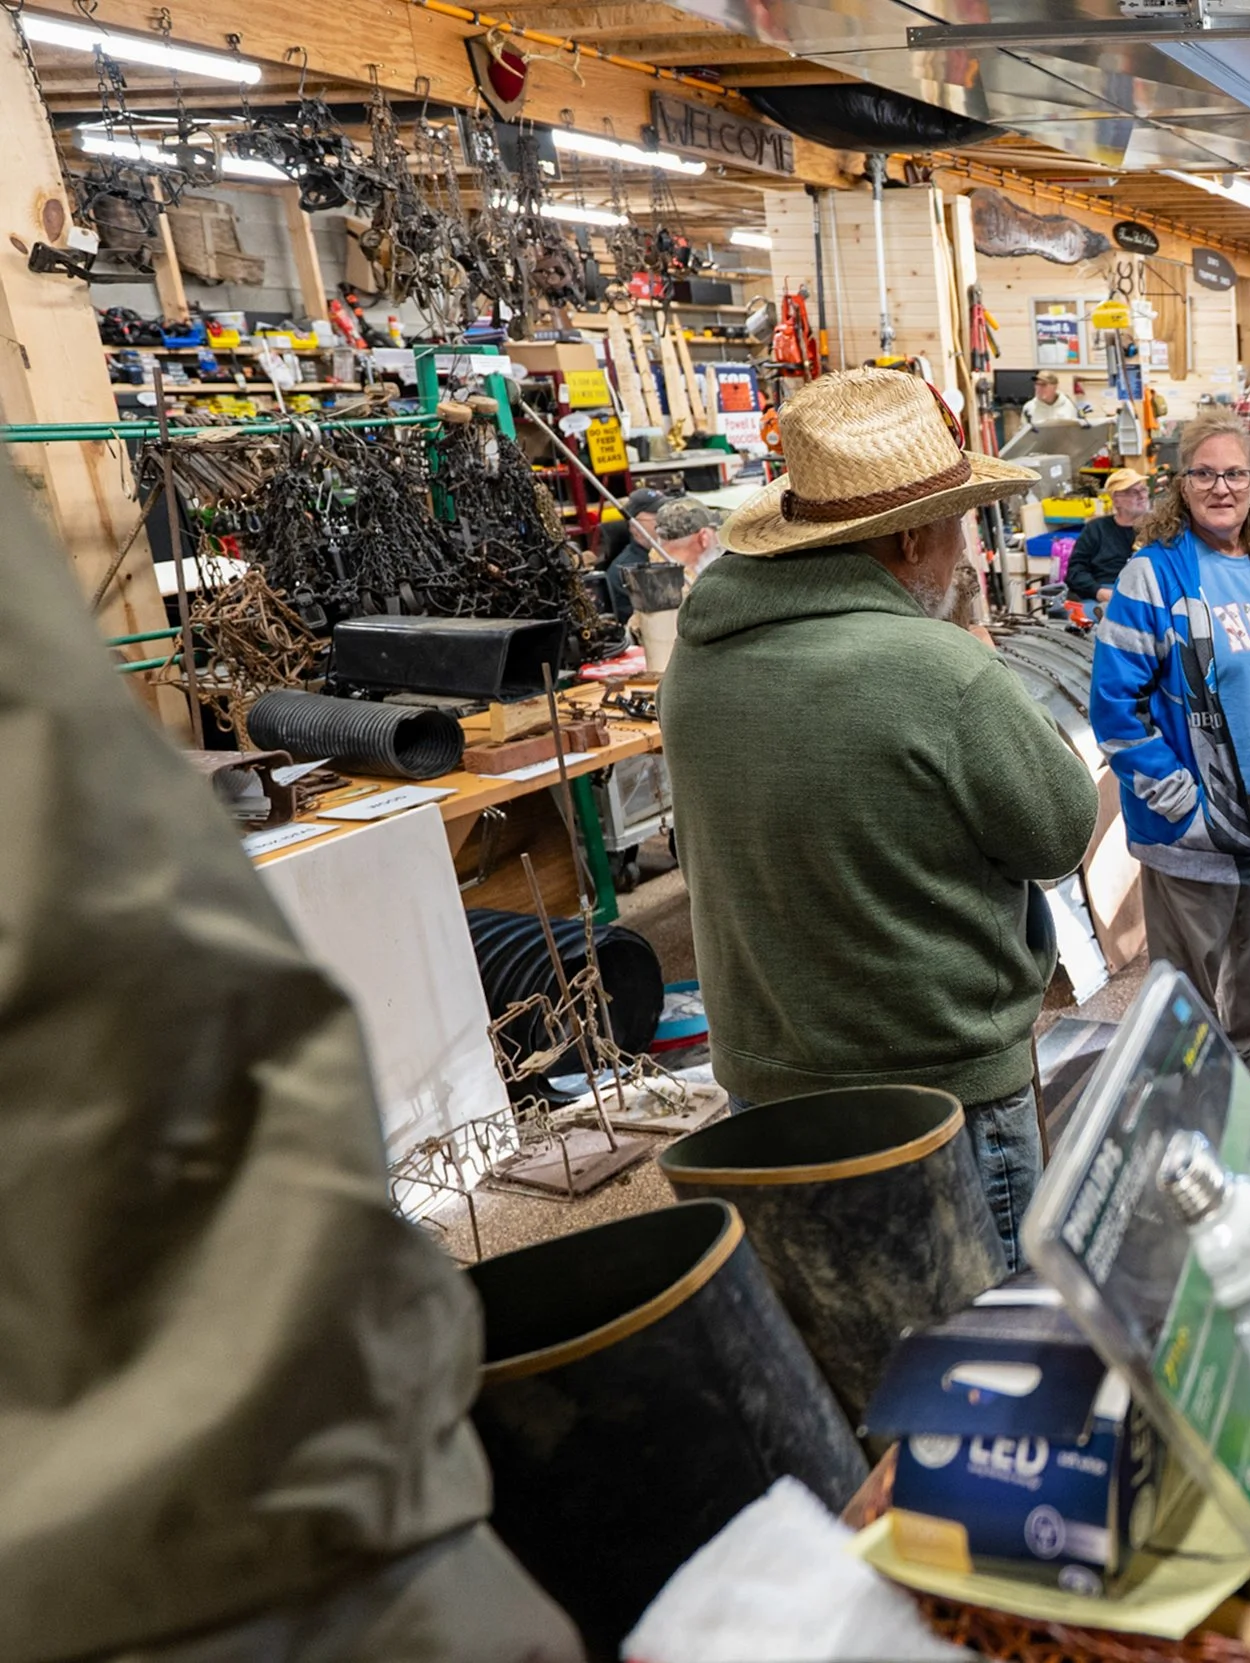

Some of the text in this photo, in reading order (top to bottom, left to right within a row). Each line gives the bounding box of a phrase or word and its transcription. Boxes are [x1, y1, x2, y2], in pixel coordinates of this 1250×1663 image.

[657, 101, 795, 173] WELCOME
[725, 418, 748, 430] Powell
[589, 428, 601, 437] DO
[596, 436, 616, 445] FEED
[600, 446, 615, 454] THE
[597, 454, 622, 464] BEARS
[969, 1434, 1050, 1478] LED
